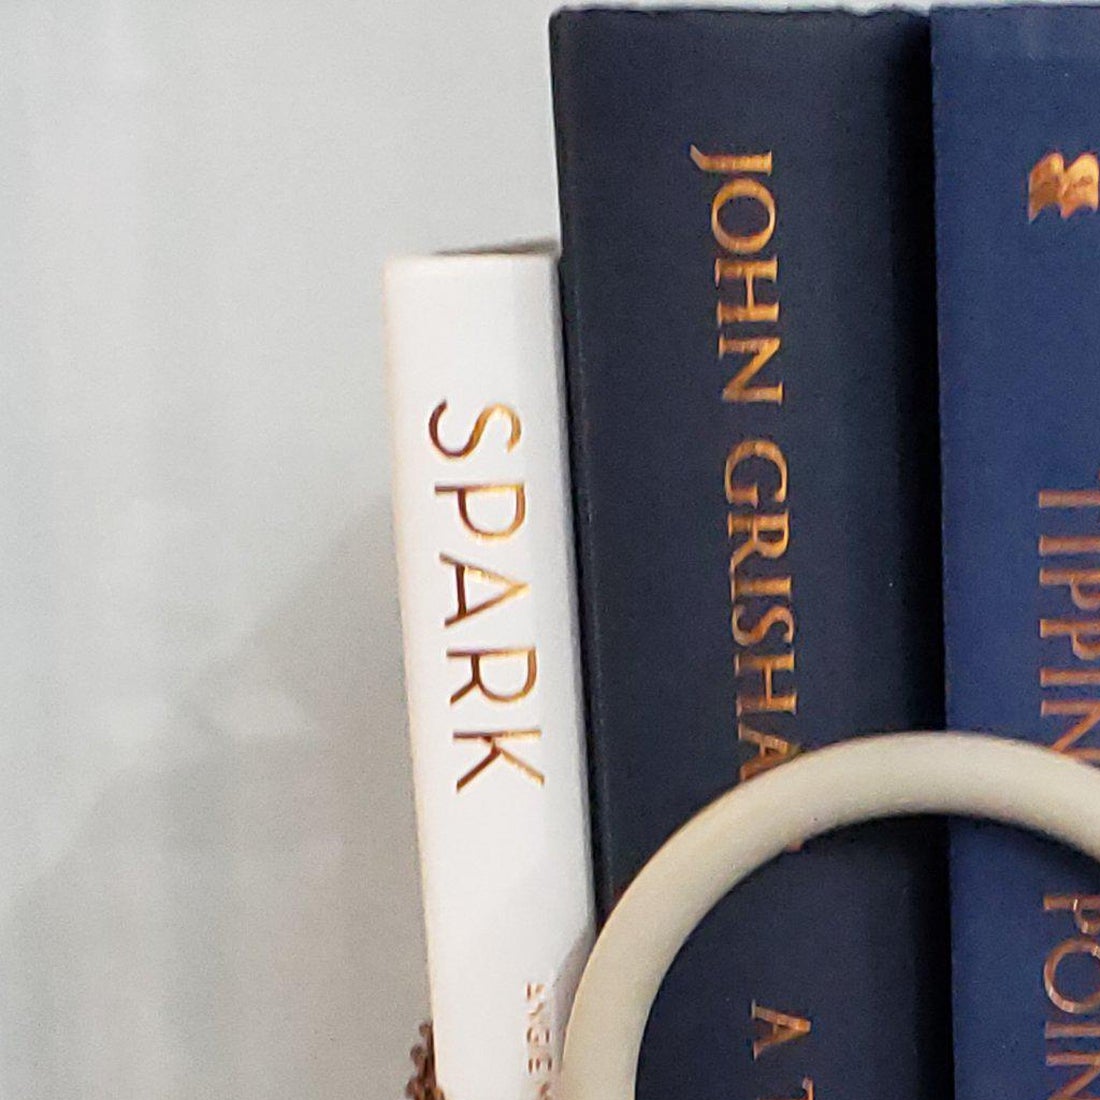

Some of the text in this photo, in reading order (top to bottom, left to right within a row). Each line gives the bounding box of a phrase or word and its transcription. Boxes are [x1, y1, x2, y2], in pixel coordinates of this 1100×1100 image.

[428, 399, 545, 794] SPARK
[690, 144, 804, 784] JOHN GRISHA
[751, 999, 811, 1061] A
